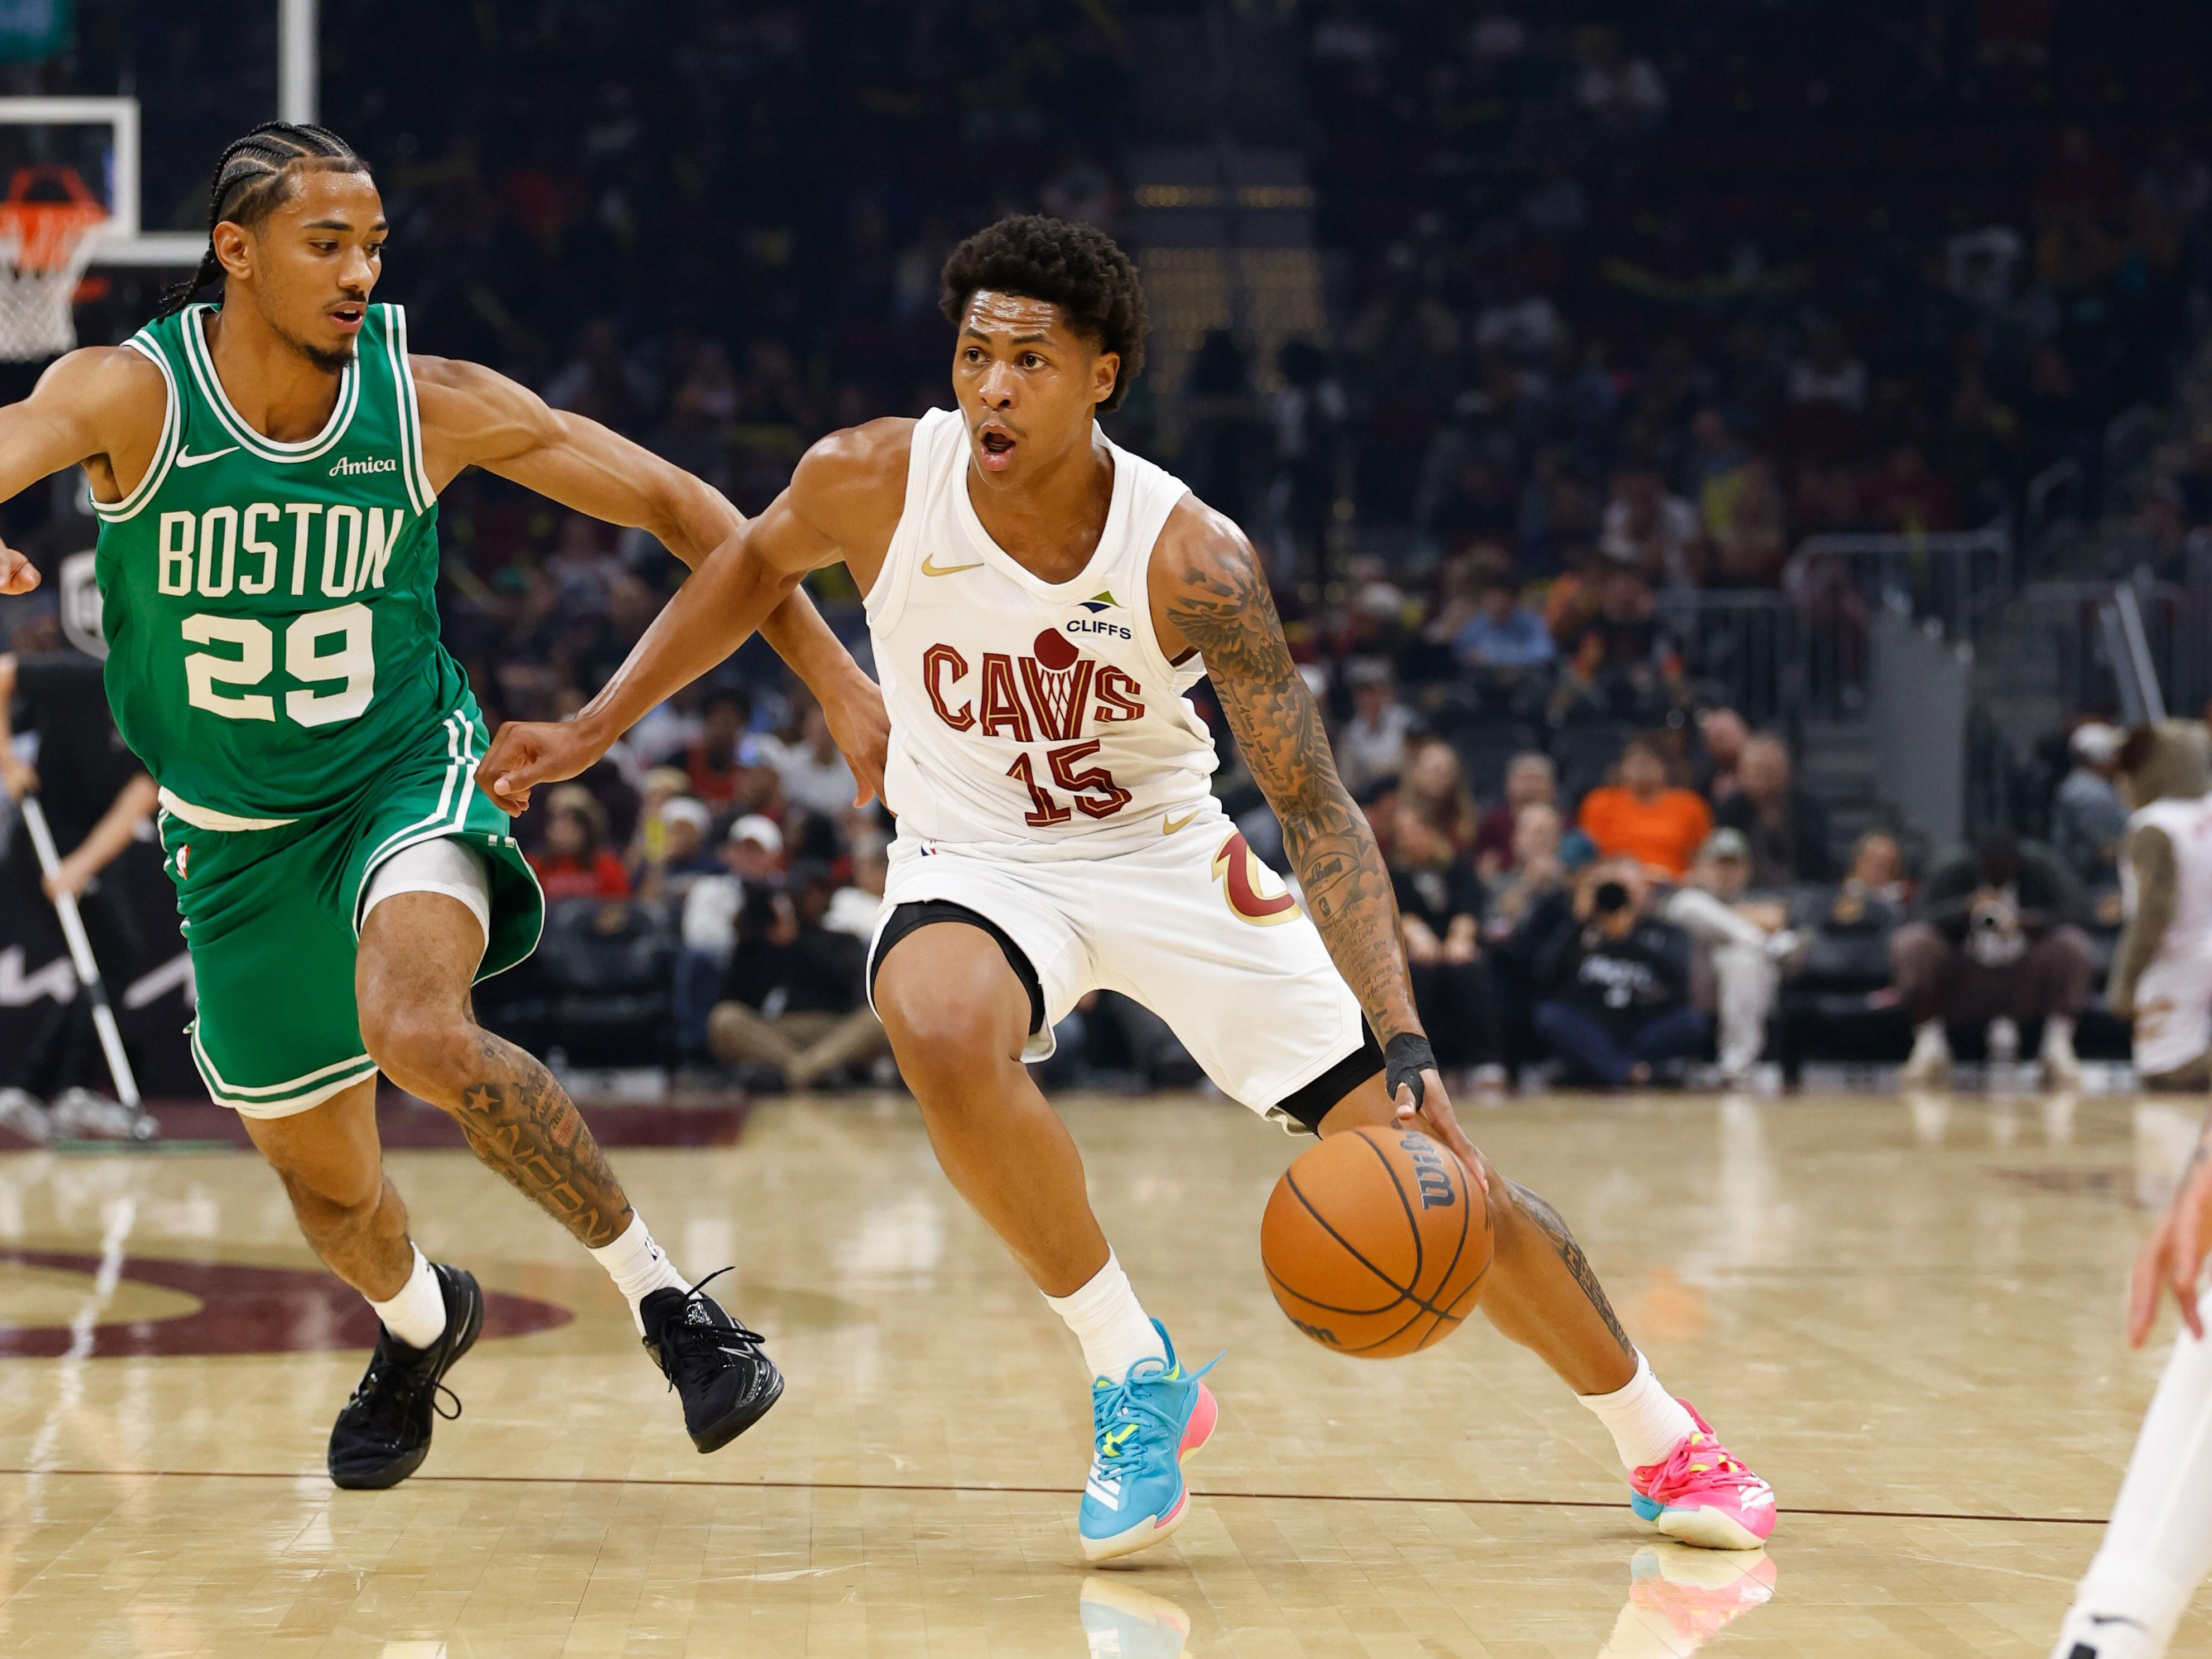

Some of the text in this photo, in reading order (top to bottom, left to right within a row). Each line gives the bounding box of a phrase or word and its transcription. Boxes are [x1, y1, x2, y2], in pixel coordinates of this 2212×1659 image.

[329, 456, 397, 477] Amica
[158, 503, 405, 597] BOSTON
[181, 601, 375, 728] 29
[1066, 620, 1131, 640] CLIFFS
[923, 643, 1145, 742] CAVS
[1006, 739, 1132, 826] 15
[1399, 1128, 1456, 1210] Wil
